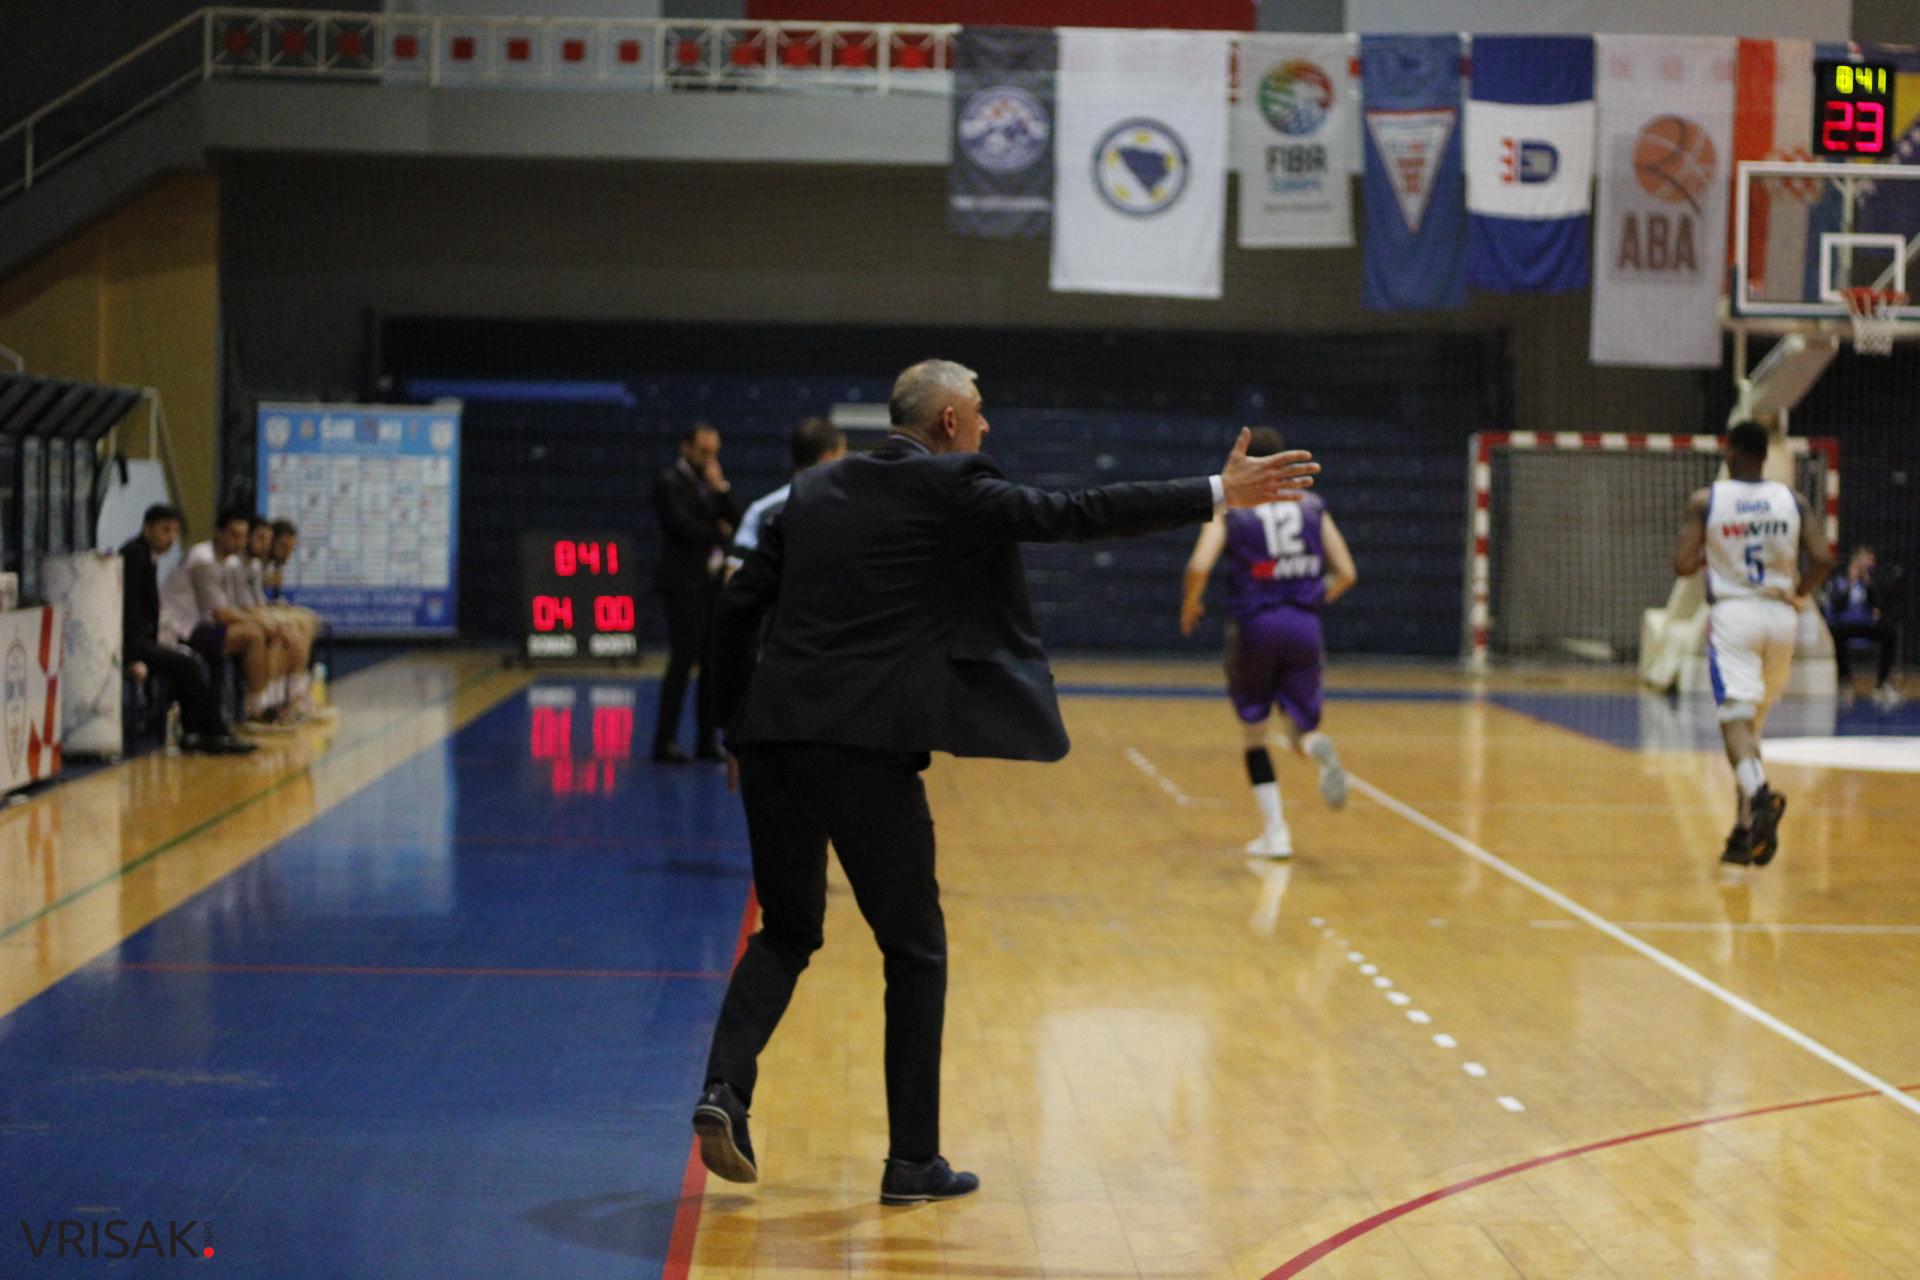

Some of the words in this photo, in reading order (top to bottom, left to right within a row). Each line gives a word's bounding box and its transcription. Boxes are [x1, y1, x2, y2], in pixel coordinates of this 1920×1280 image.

[1822, 100, 1885, 153] 23
[1617, 217, 1699, 272] ABA
[1255, 500, 1306, 558] 12
[1744, 544, 1766, 586] 5
[532, 595, 574, 631] 04
[594, 595, 635, 631] 00
